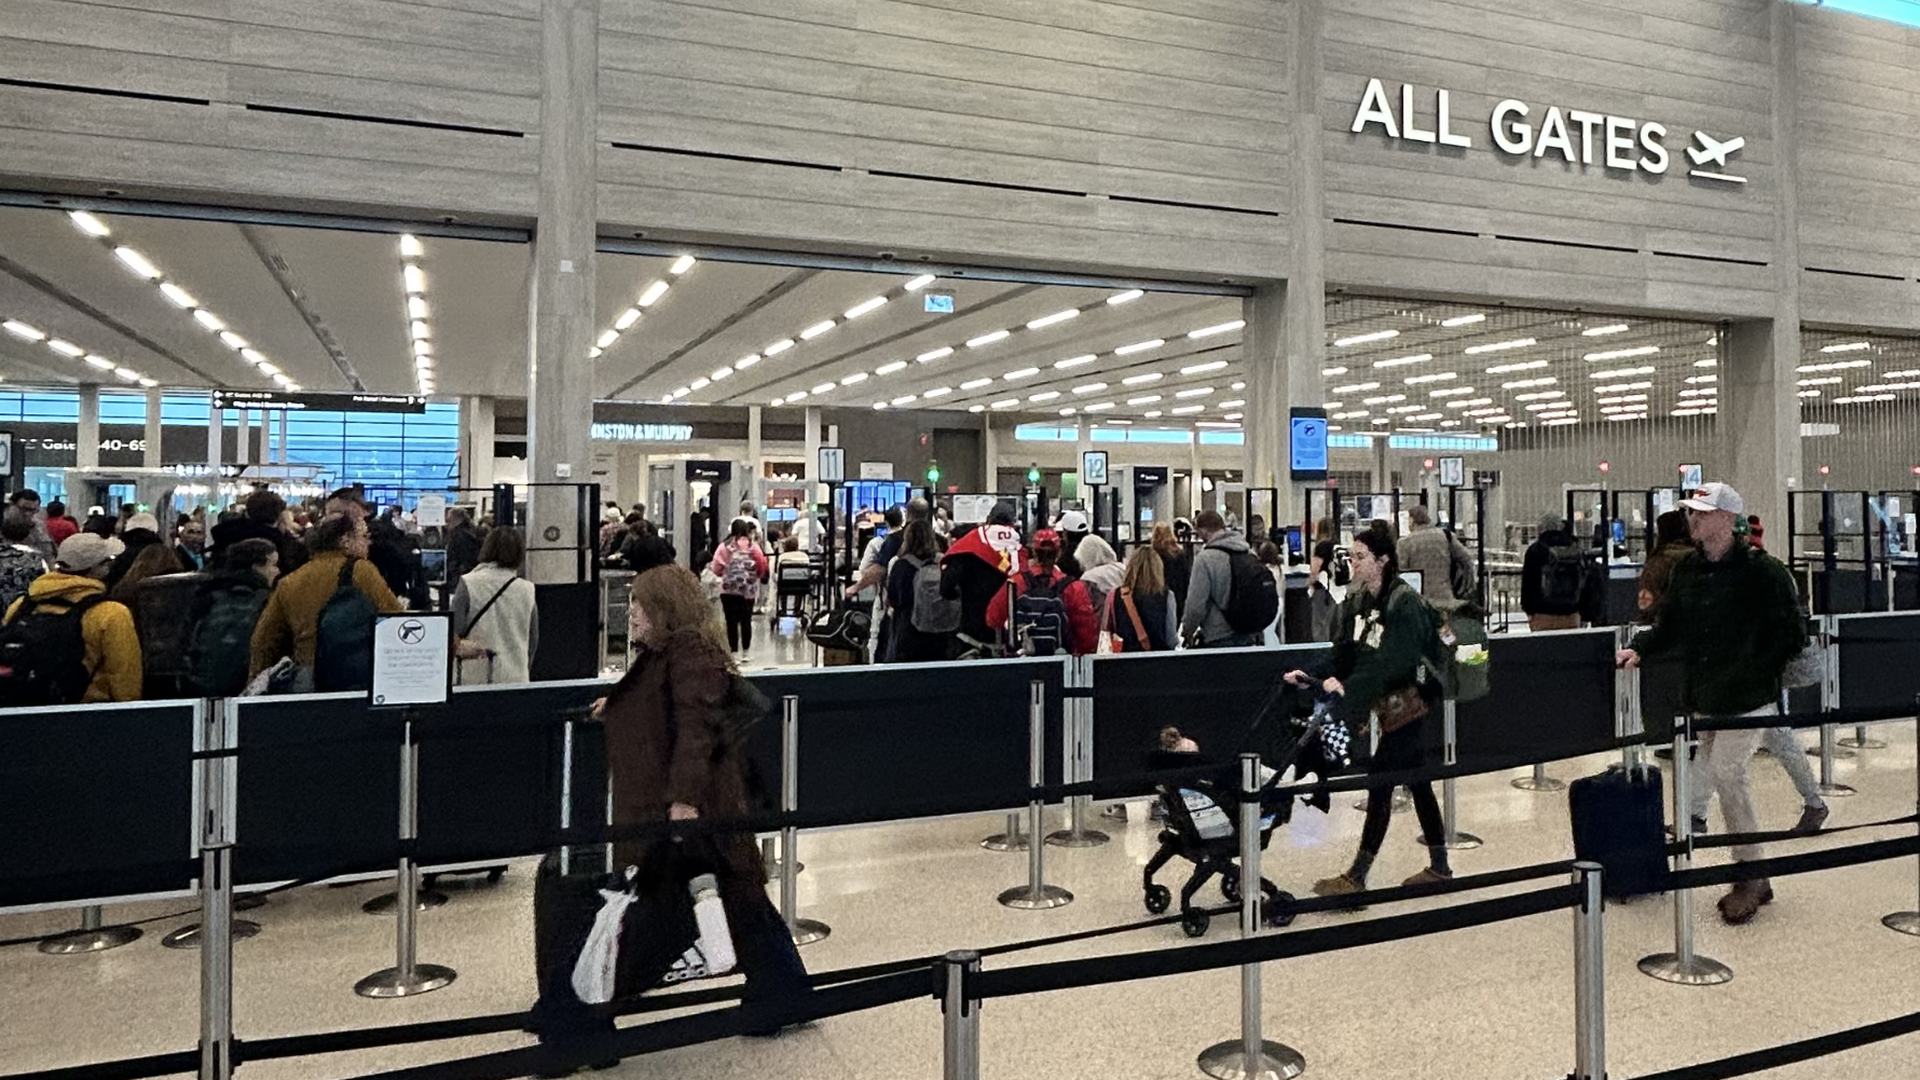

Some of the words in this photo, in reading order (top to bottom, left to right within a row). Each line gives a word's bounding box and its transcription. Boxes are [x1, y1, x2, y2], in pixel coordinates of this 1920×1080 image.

[1351, 77, 1472, 148] ALL
[1490, 98, 1670, 174] GATES
[42, 438, 77, 450] Gate
[97, 439, 147, 451] 40-69
[824, 450, 838, 479] 11
[1087, 458, 1104, 478] 12
[1443, 459, 1460, 482] 13
